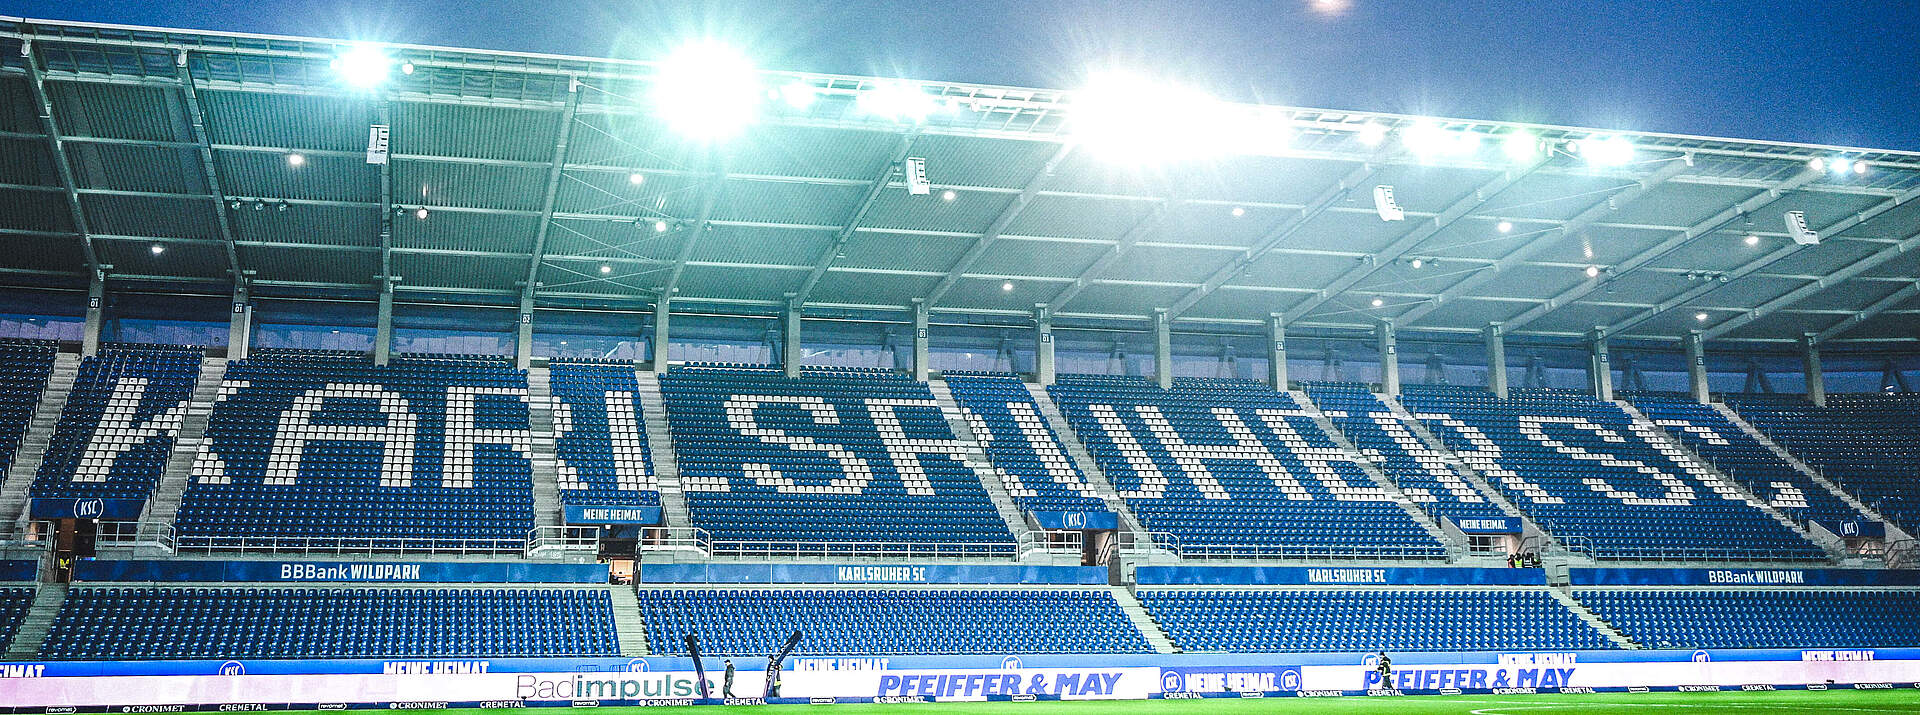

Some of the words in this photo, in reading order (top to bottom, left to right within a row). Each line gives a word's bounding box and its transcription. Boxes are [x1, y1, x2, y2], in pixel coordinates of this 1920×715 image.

[583, 508, 609, 521] MEINE
[610, 508, 644, 521] HEIMAT.
[1459, 518, 1480, 530] MEINE
[1480, 518, 1508, 530] HEIMAT.
[281, 564, 347, 580] BBBank
[350, 564, 421, 581] WILDPARK
[838, 566, 910, 582] KARLSRUHER
[912, 566, 926, 581] SC
[1308, 569, 1372, 582] KARLSRUHER
[1373, 569, 1386, 583] SC
[1708, 569, 1755, 583] BBBank
[1755, 569, 1805, 583] WILDPARK
[383, 661, 431, 675] MEINE
[432, 661, 490, 675] HEIMAT
[793, 658, 836, 671] MEINE
[837, 658, 889, 670] HEIMAT
[877, 673, 1022, 696] PFEIFFER
[1025, 673, 1049, 696] &
[1054, 672, 1123, 696] MAY
[1184, 673, 1225, 691] MEINE
[1492, 668, 1511, 689] &
[1517, 668, 1576, 689] MAY
[131, 705, 185, 714] CRONIMET
[219, 703, 268, 712] CREMETAL
[398, 702, 449, 711] CRONIMET
[647, 699, 694, 707] CRONIMET
